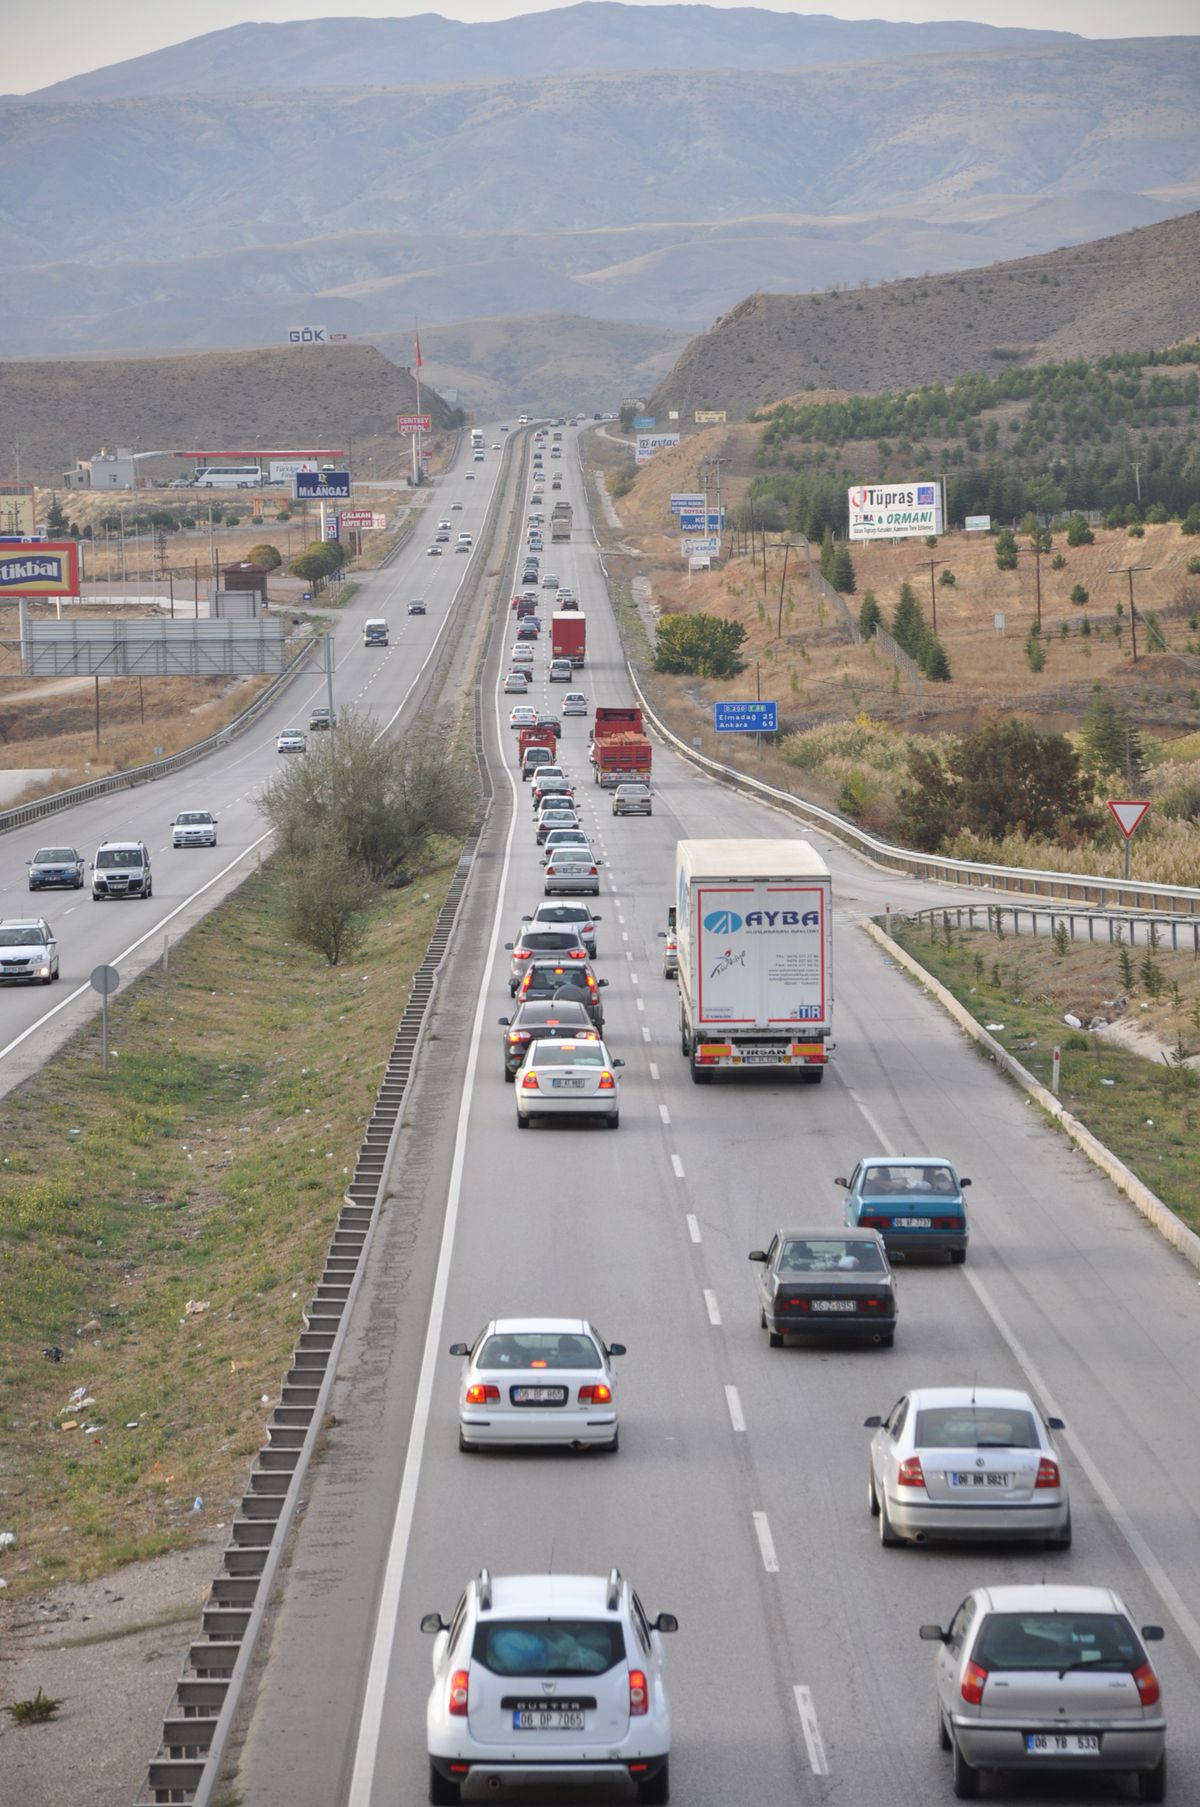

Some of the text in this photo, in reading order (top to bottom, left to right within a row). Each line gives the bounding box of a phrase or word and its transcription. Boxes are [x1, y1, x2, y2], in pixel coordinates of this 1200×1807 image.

[289, 327, 325, 342] GÖK
[867, 489, 914, 509] Tüpraş
[854, 511, 933, 526] TEMA ORMANI
[745, 910, 819, 927] AYBA
[800, 1006, 820, 1018] TIR
[958, 1472, 968, 1485] 06
[521, 1712, 582, 1728] 06 DP 7065
[1035, 1735, 1047, 1749] 06
[1077, 1735, 1097, 1750] 533
